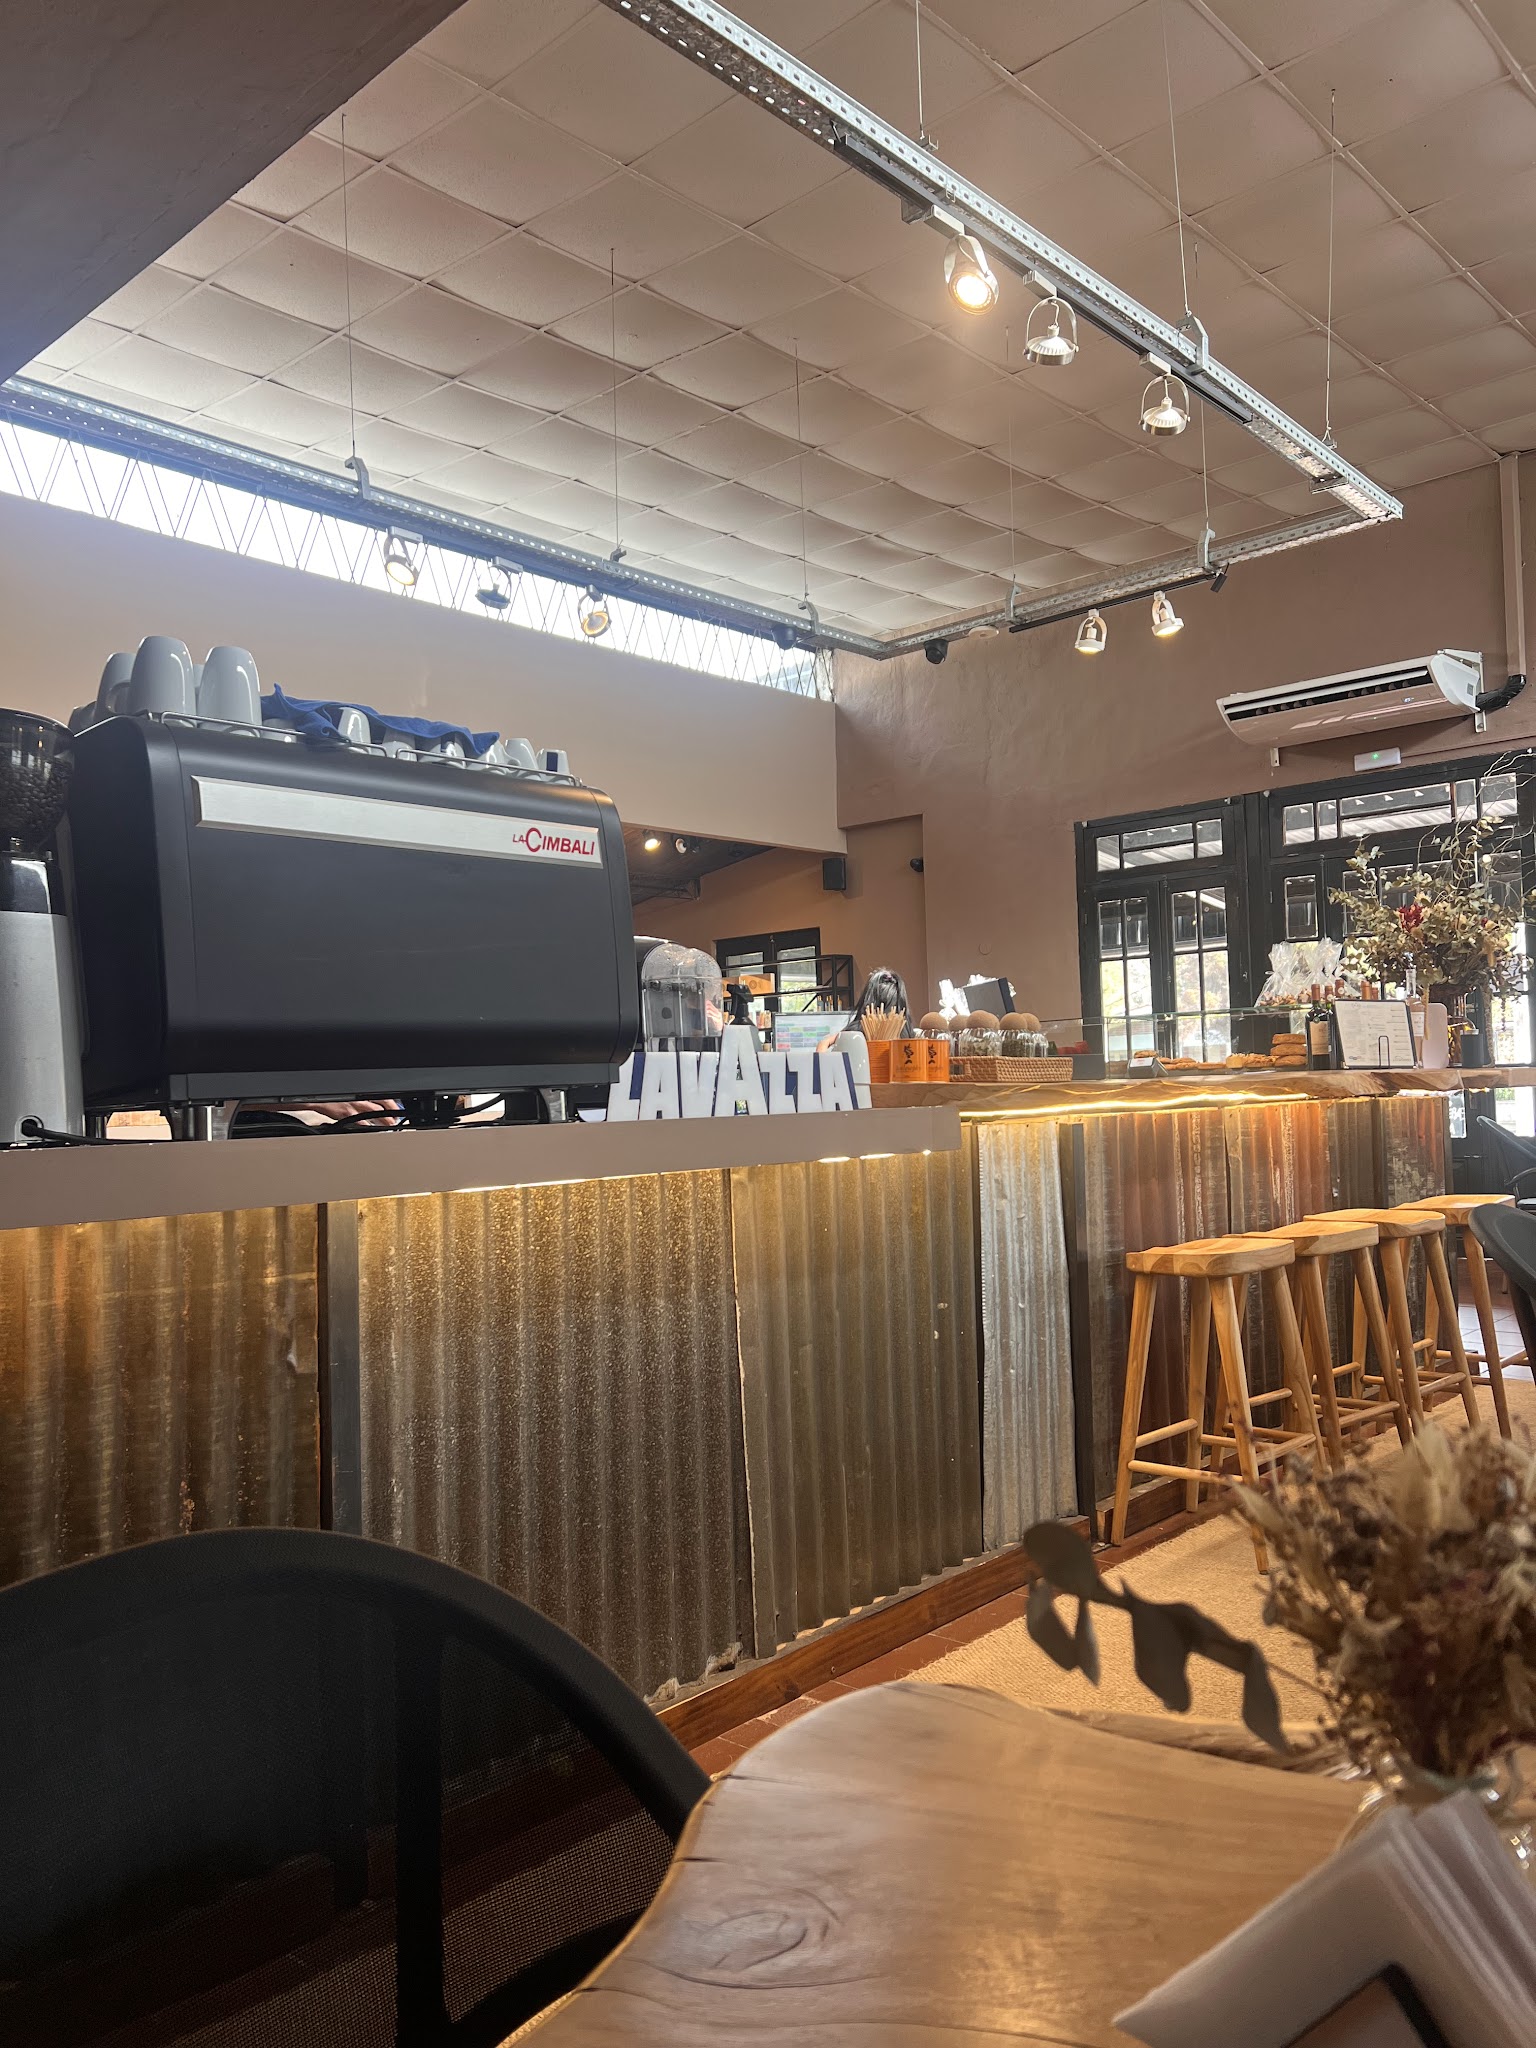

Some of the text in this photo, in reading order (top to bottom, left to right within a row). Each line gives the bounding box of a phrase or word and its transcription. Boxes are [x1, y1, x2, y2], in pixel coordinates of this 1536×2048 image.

[512, 827, 595, 856] LA CIMBALI
[607, 1024, 859, 1121] LAVAZZA
